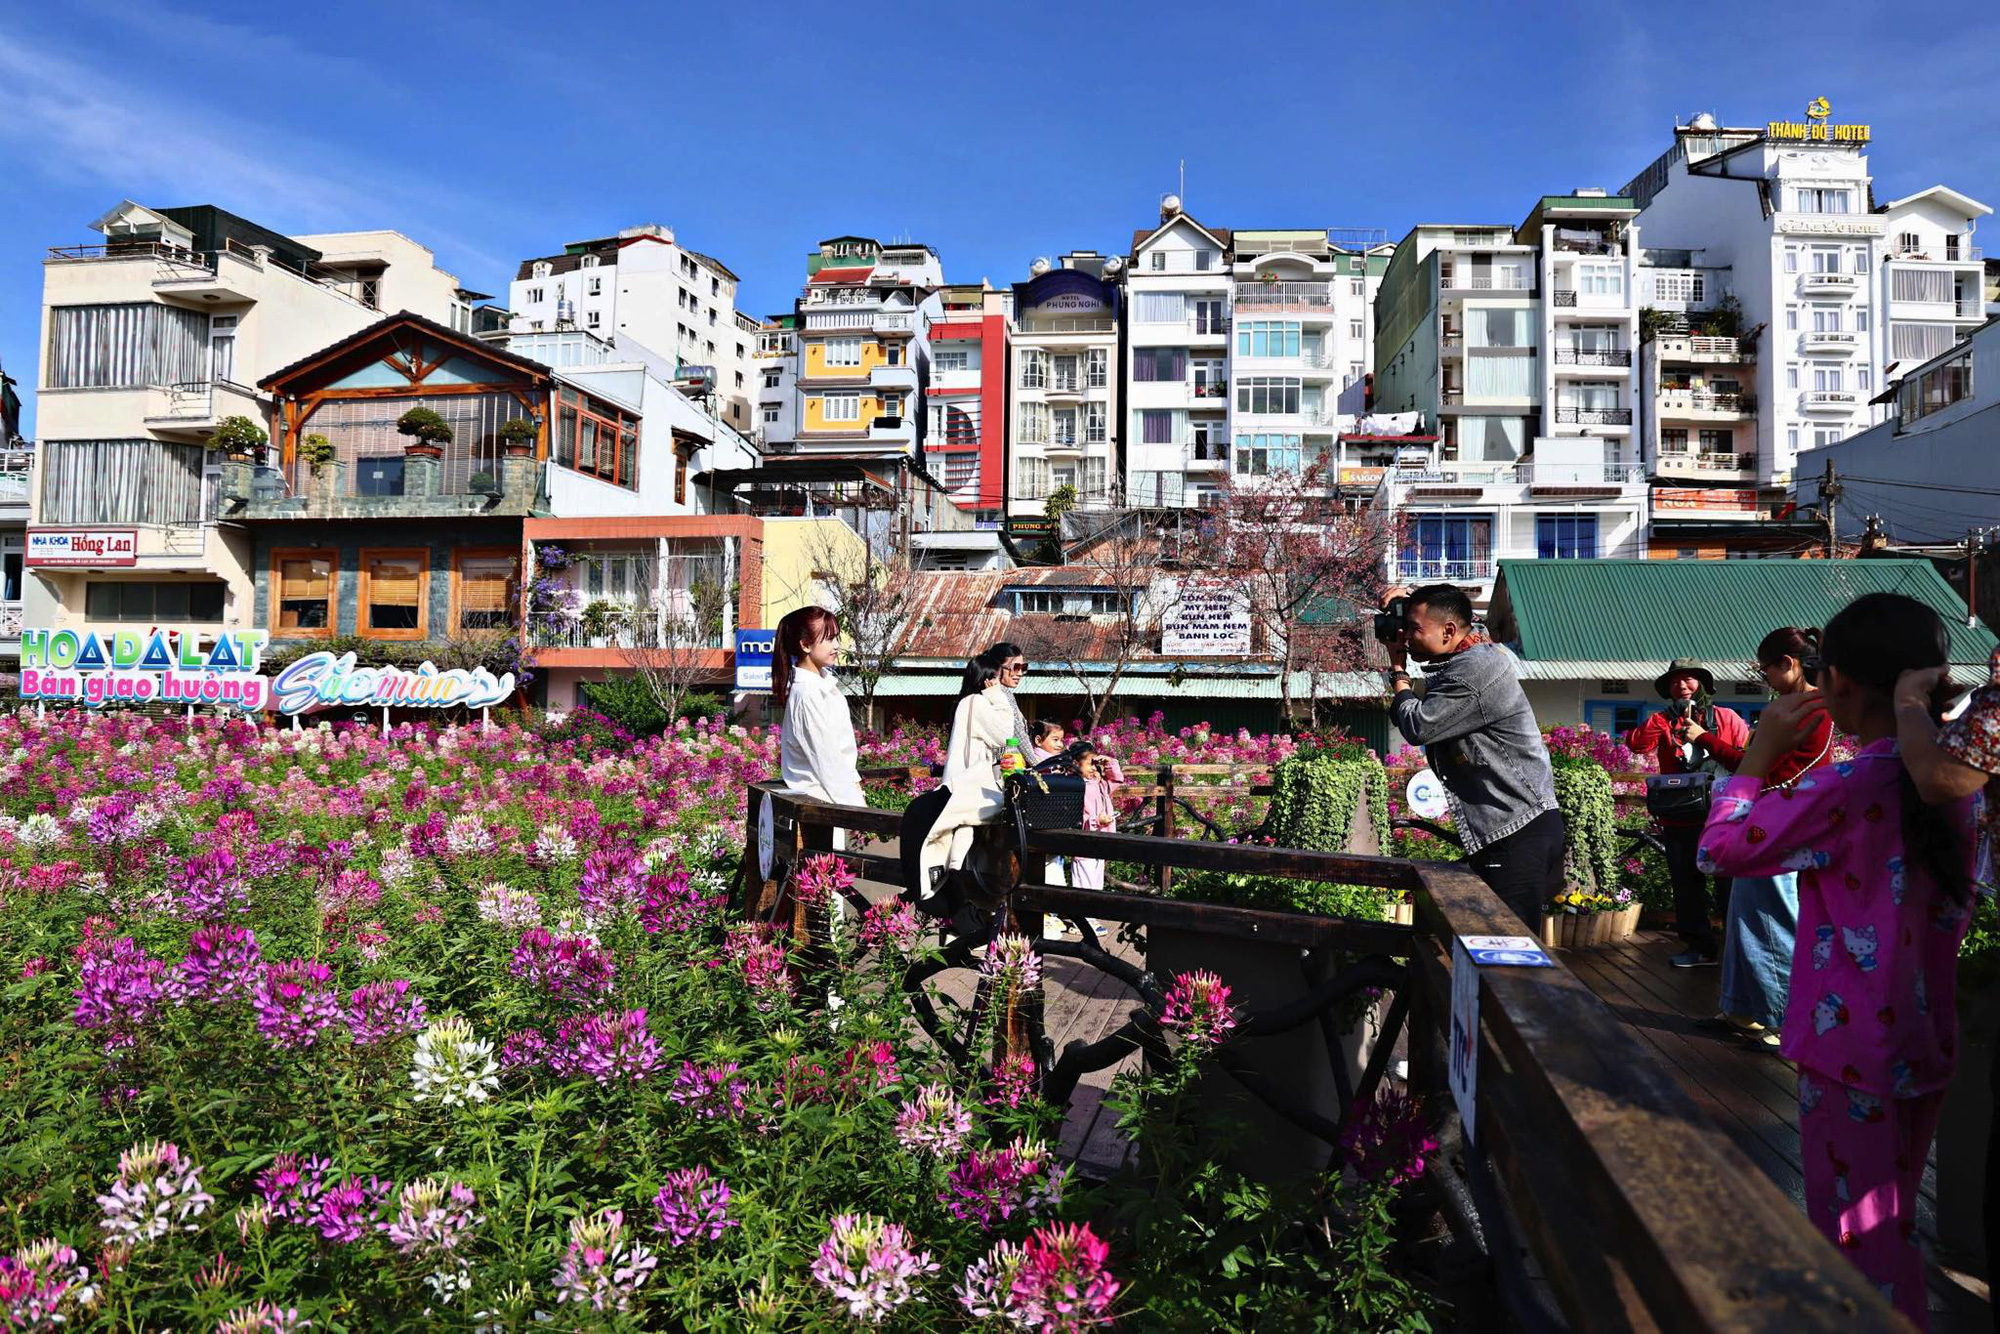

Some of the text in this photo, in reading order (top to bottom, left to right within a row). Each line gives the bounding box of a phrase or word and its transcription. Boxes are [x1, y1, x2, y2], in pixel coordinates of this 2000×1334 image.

[1768, 120, 1806, 139] THÀNH
[1834, 124, 1870, 141] HOTEL
[32, 536, 48, 546] NHA
[48, 536, 69, 546] KHOA
[71, 533, 105, 556] Hồng
[107, 536, 131, 552] Lan
[20, 630, 107, 669] HOA
[20, 670, 77, 698] Bản
[85, 670, 155, 704] giao
